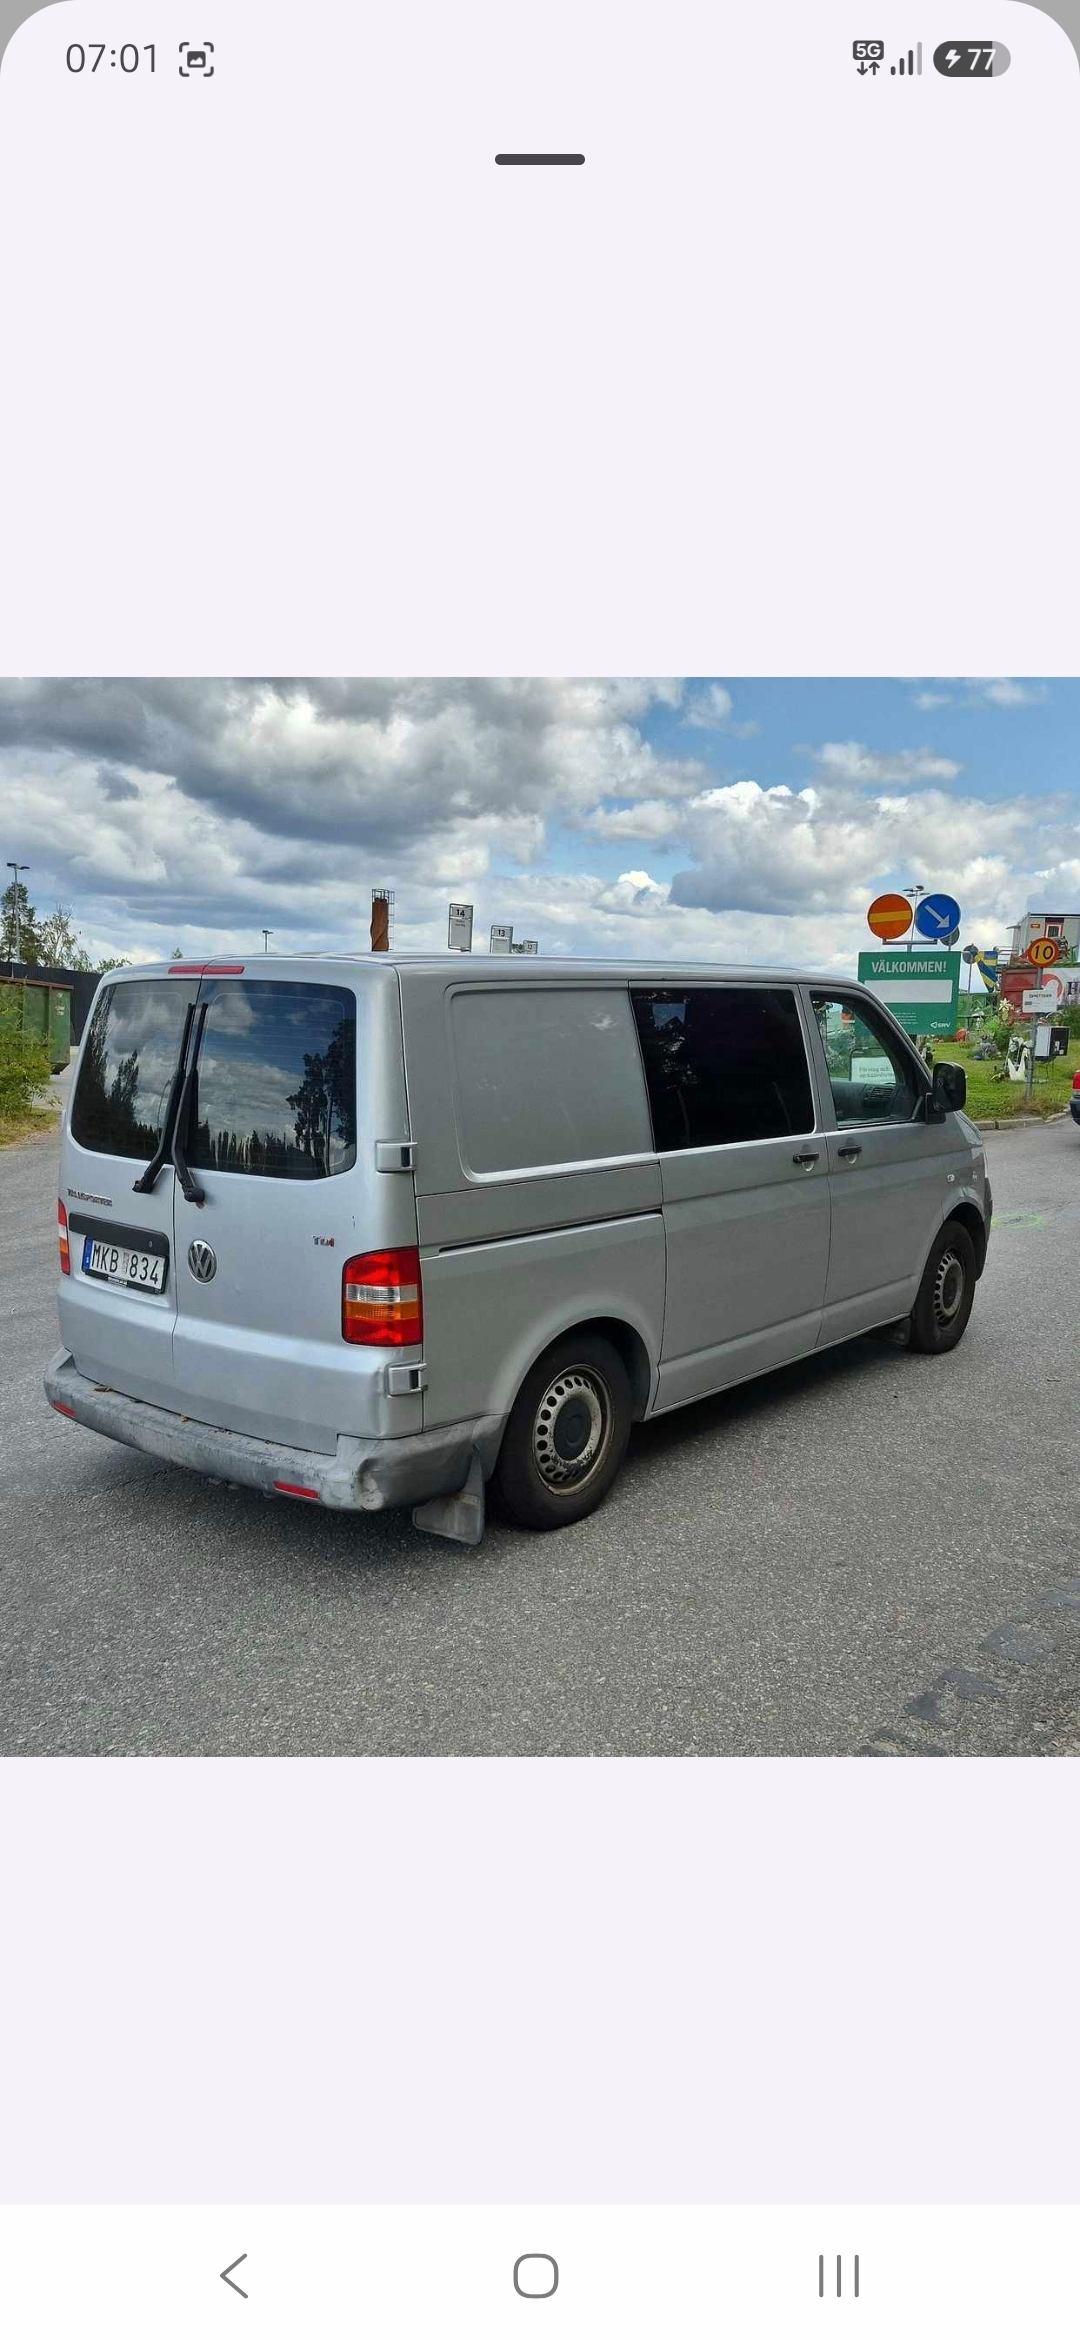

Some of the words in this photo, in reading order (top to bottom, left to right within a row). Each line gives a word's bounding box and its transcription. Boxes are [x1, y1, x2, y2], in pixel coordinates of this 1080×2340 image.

[456, 909, 466, 917] 14
[498, 929, 506, 937] 13
[1034, 945, 1054, 960] 10
[871, 959, 947, 973] VÄLKOMMEN!
[91, 1243, 119, 1273] MKB
[129, 1254, 159, 1285] 834
